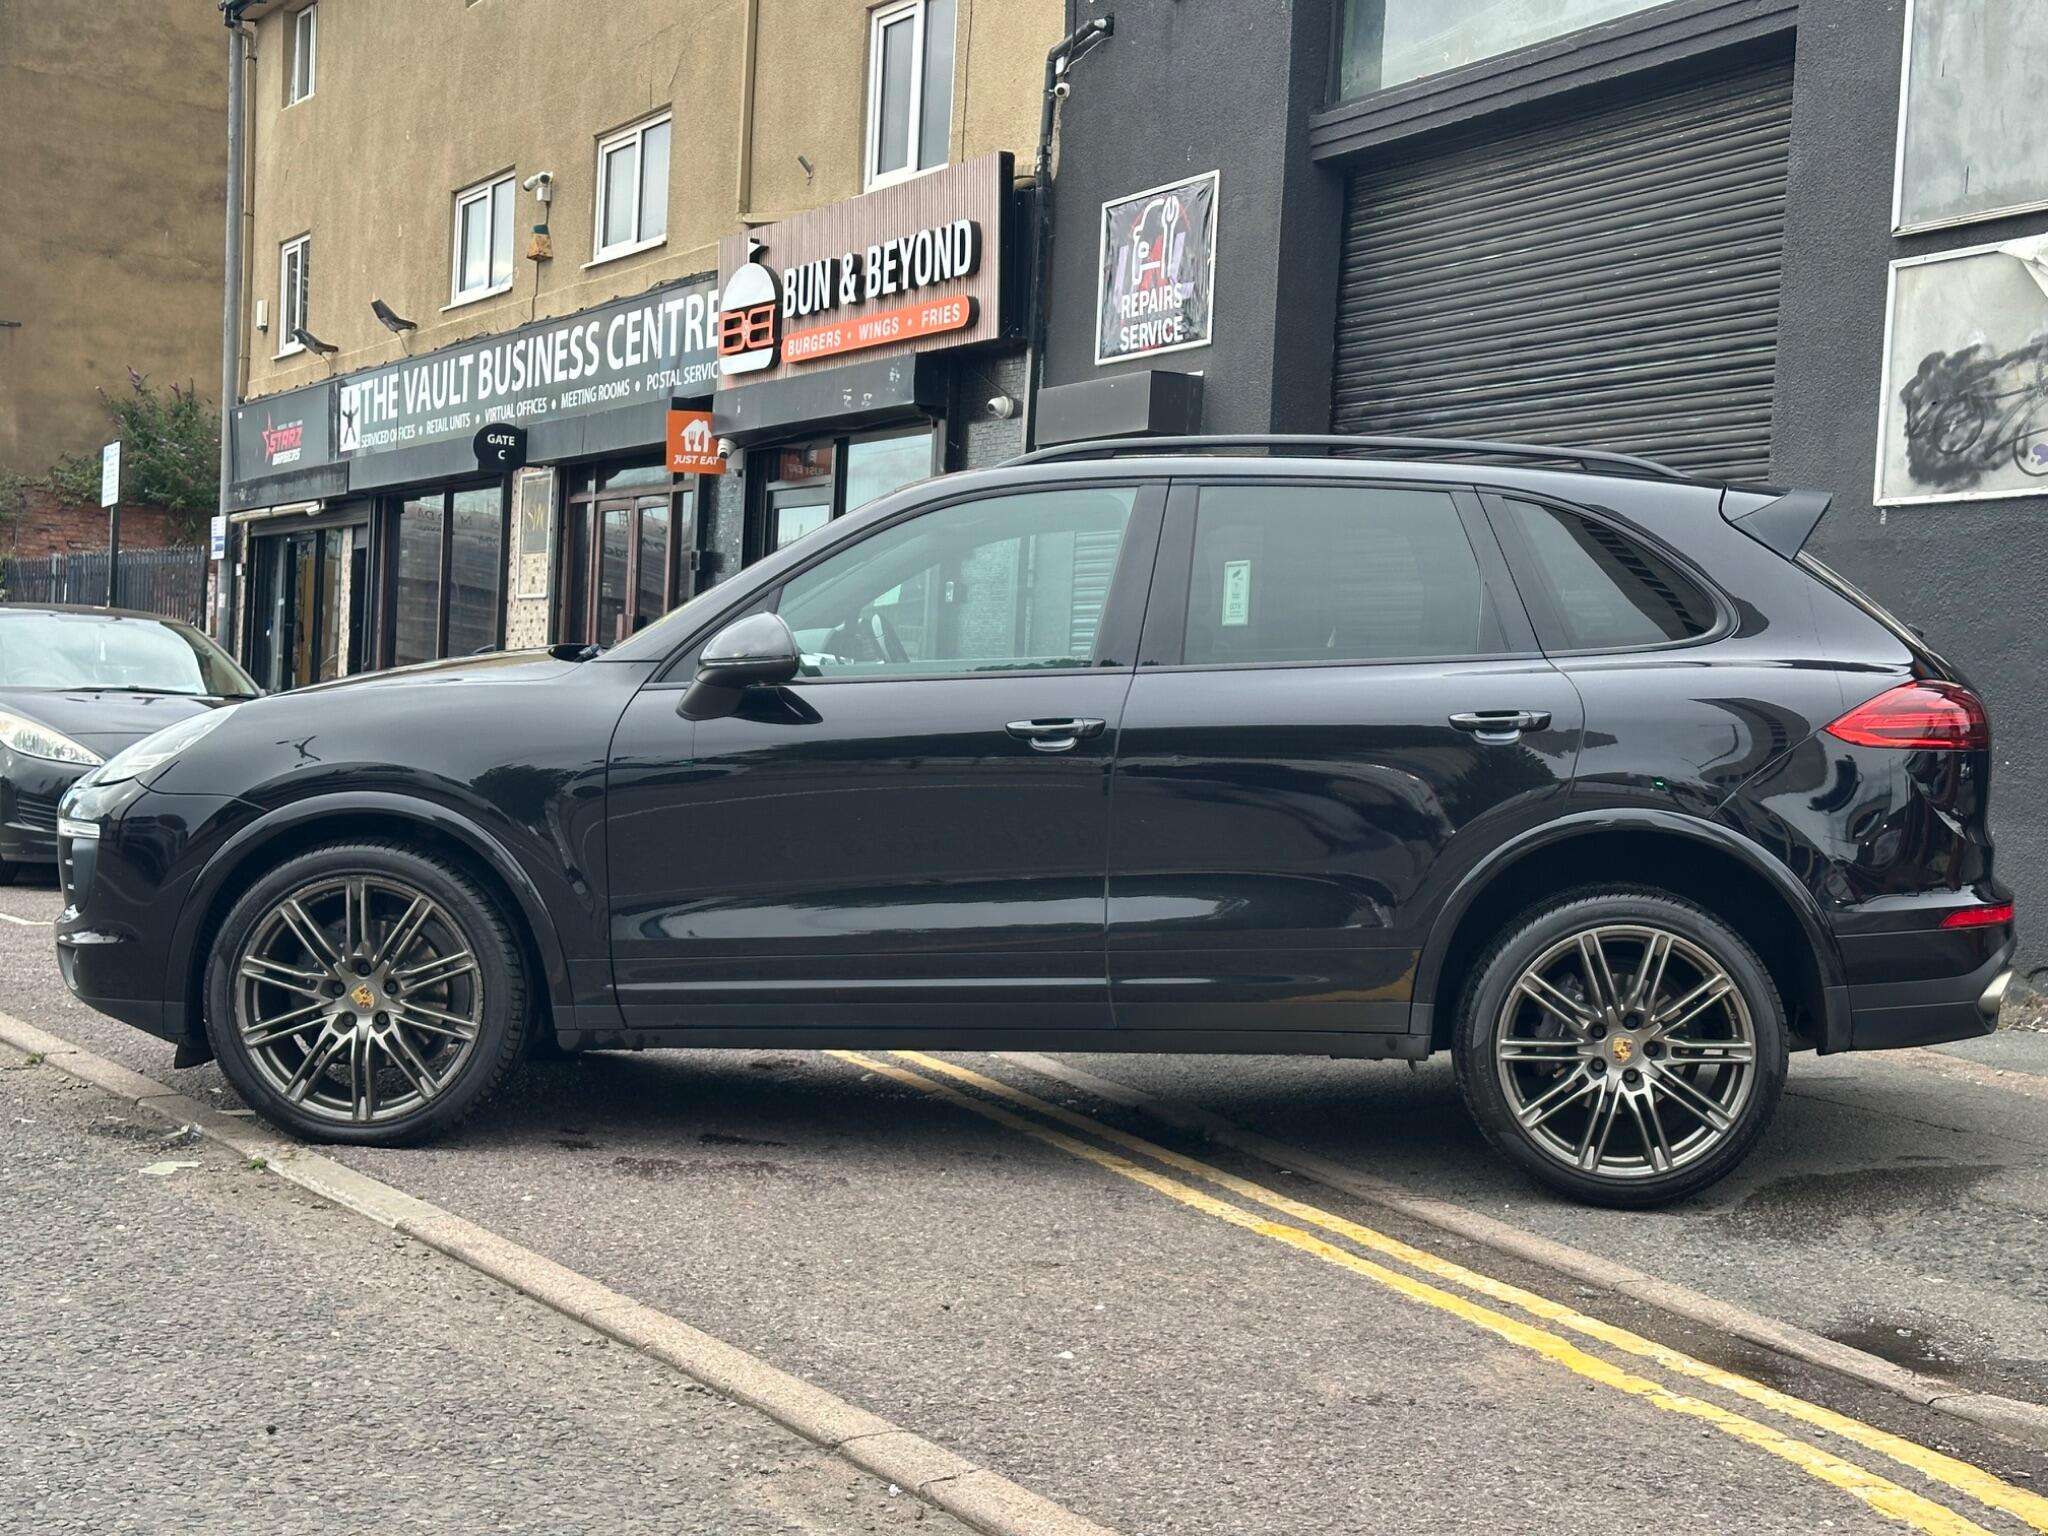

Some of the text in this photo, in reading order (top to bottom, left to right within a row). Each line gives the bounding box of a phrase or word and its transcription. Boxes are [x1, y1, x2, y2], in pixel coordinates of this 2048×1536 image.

[783, 219, 973, 318] BUN & BEYOND
[1120, 282, 1183, 320] REPAIRS
[788, 304, 961, 356] BURGERS WINGS FRIES
[1120, 315, 1184, 352] SERVICE
[361, 289, 718, 425] THE VAULT BUSINESS CENTRE
[361, 430, 389, 449] SERVICED
[426, 417, 449, 435] RETAIL
[449, 412, 471, 431] UNITS
[484, 403, 516, 424] VIRTUAL
[516, 397, 547, 417] OFFICES
[561, 386, 597, 408] MEETING
[600, 379, 630, 402] ROOMS
[647, 369, 682, 391] POSTAL
[487, 434, 515, 446] GATE
[498, 450, 505, 460] C
[673, 455, 719, 466] JUST EAT
